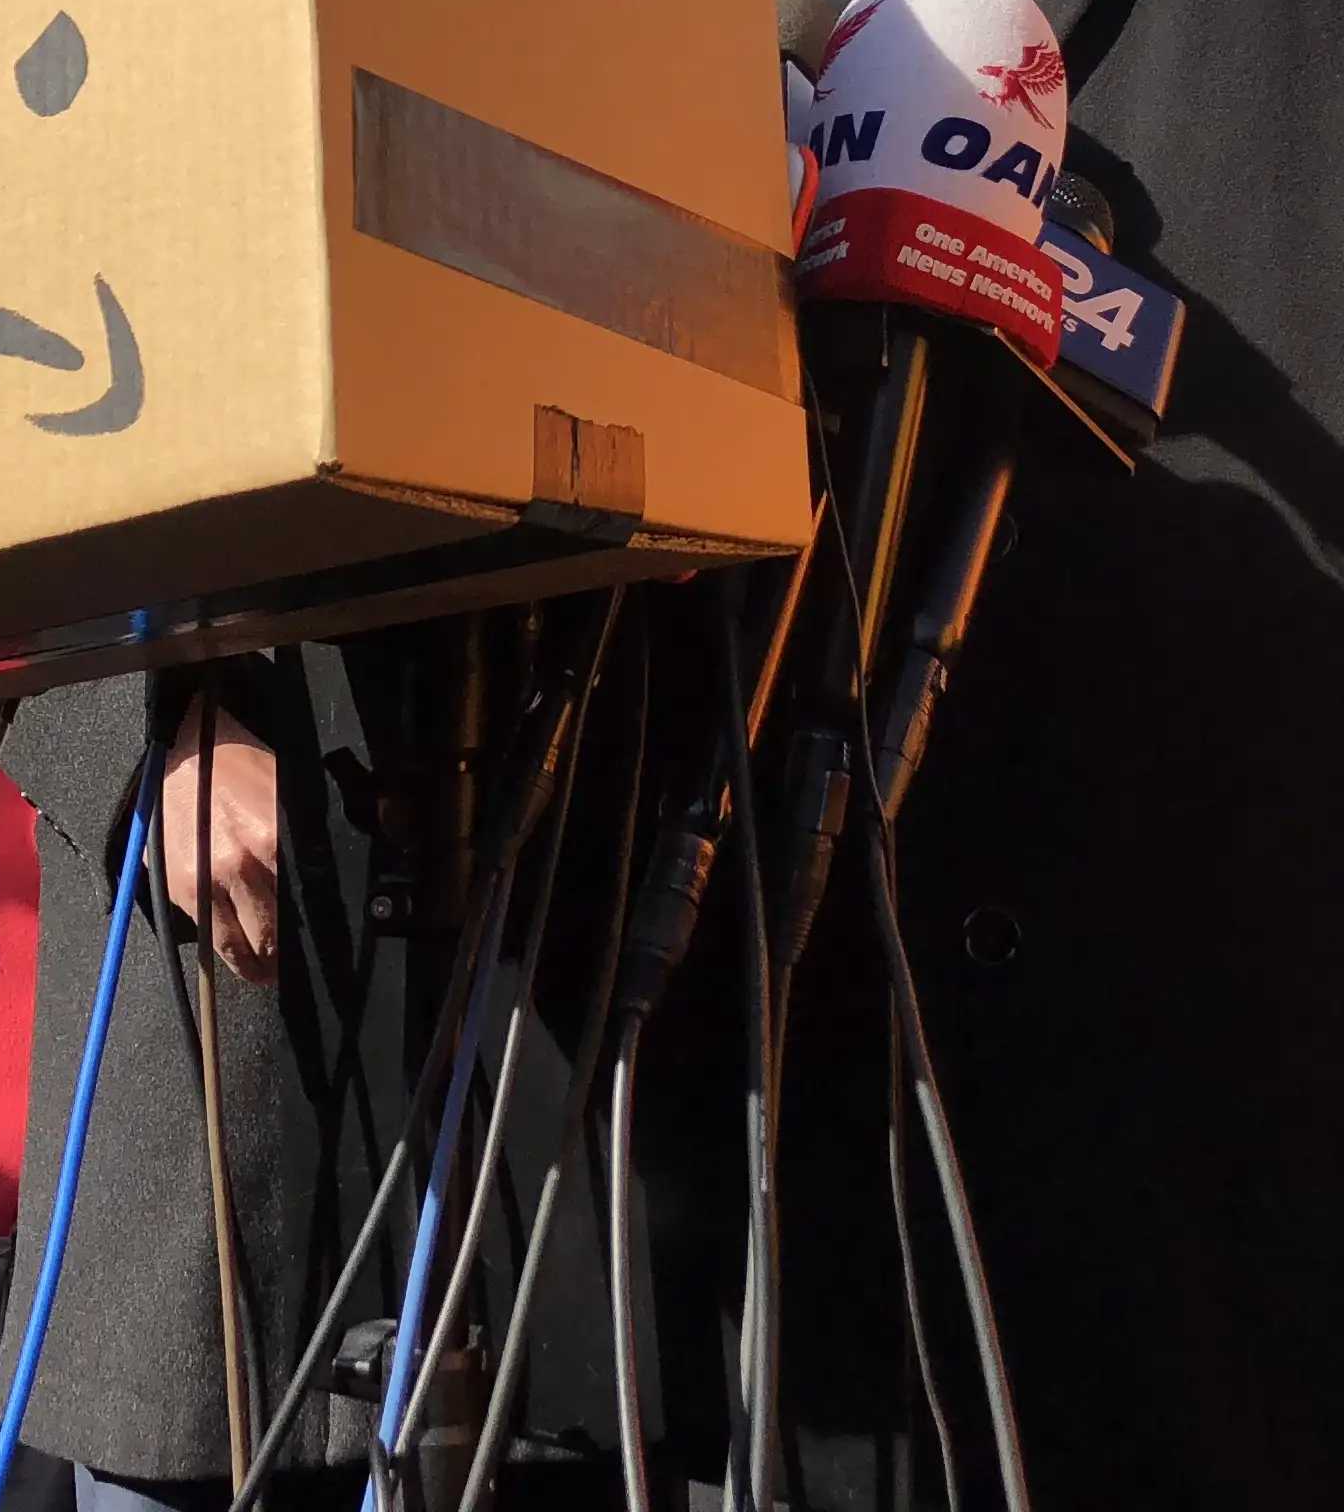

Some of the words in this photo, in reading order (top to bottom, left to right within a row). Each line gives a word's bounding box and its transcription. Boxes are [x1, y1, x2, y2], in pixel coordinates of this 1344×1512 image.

[896, 245, 968, 287] News
[969, 272, 1056, 335] Network
[914, 222, 966, 256] One
[967, 244, 1053, 302] America
